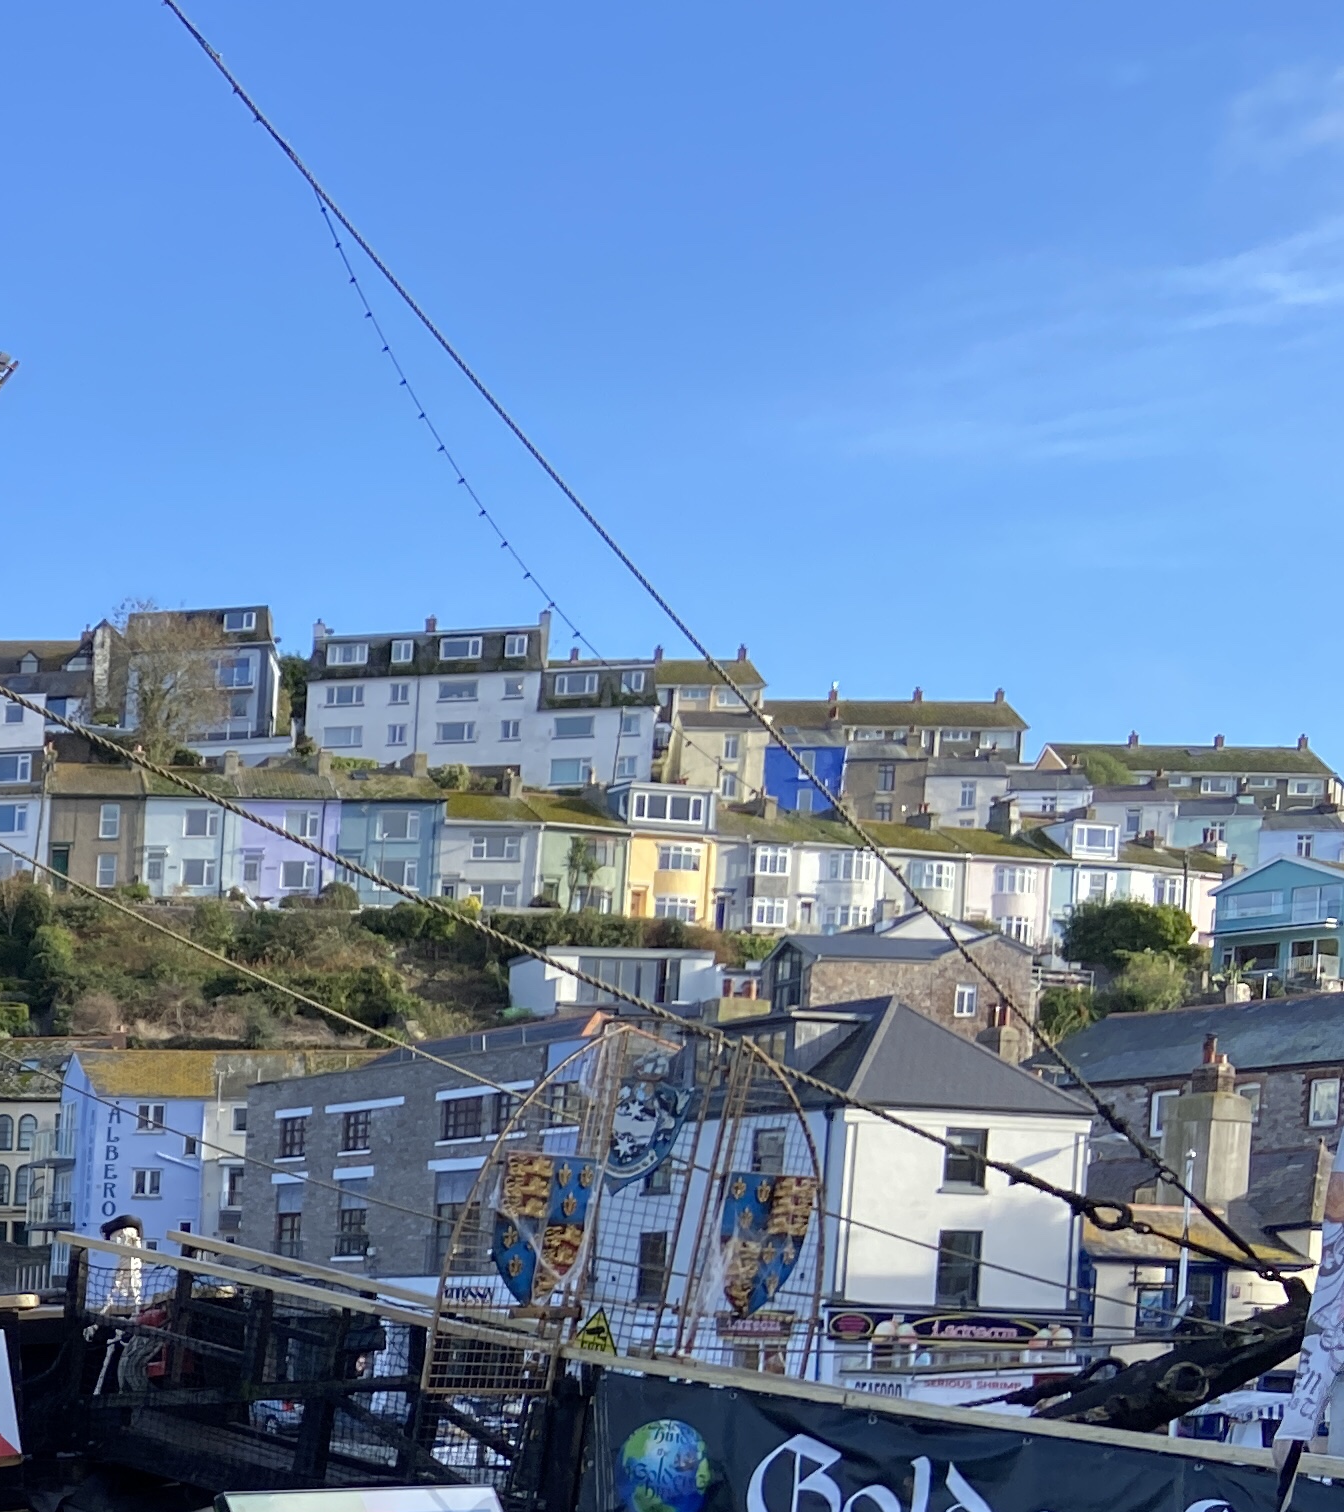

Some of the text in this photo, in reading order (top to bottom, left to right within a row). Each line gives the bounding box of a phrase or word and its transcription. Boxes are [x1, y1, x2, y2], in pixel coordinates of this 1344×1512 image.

[580, 1340, 607, 1352] CCTV
[923, 1380, 1022, 1391] SERIOUS SHRIMP
